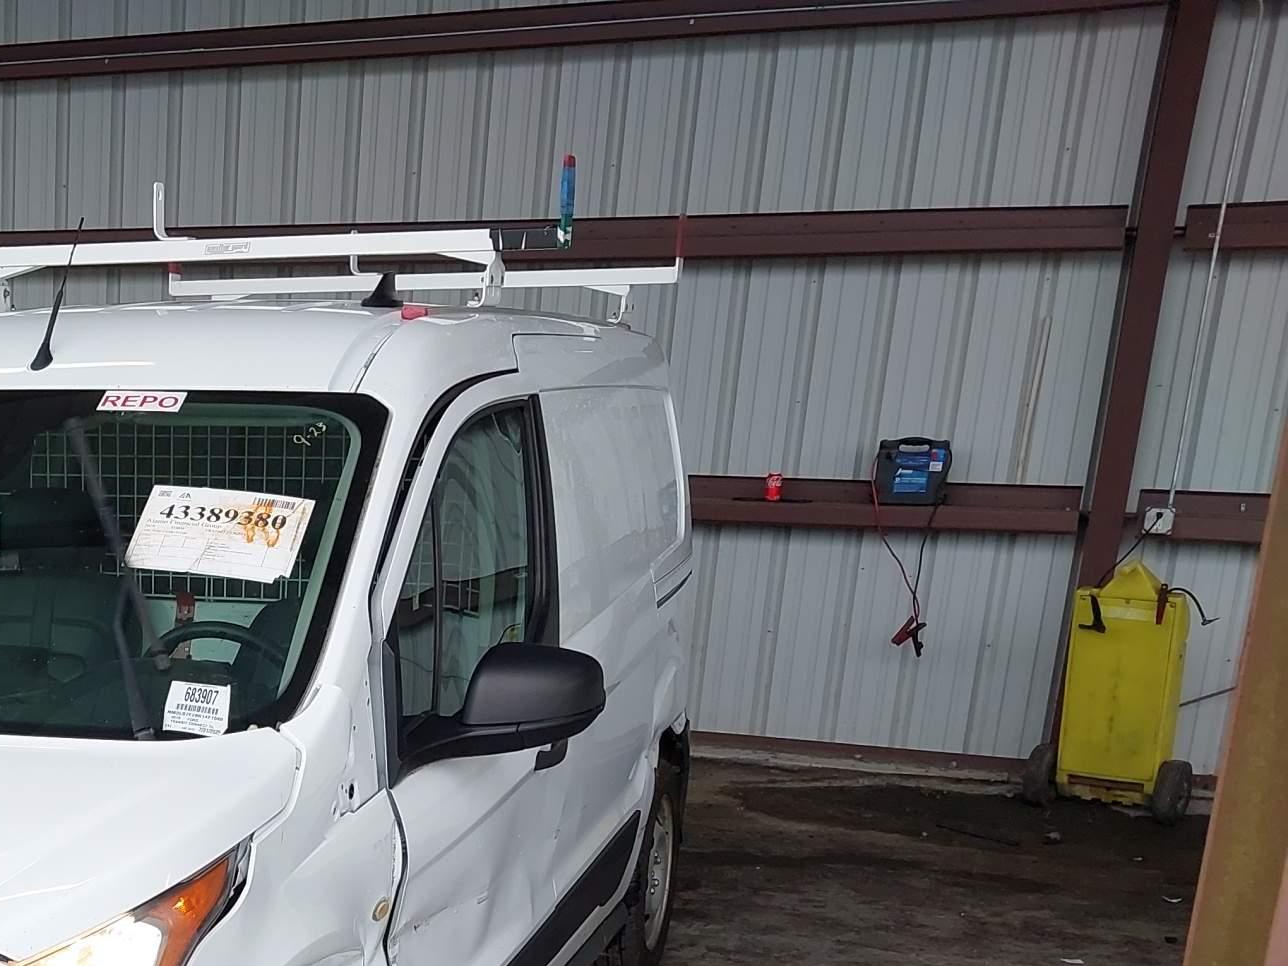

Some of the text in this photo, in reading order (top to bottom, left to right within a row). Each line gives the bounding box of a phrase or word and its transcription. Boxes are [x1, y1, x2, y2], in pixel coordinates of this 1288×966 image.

[100, 395, 180, 409] REPO
[159, 503, 287, 530] 43389380
[184, 686, 219, 705] 683907
